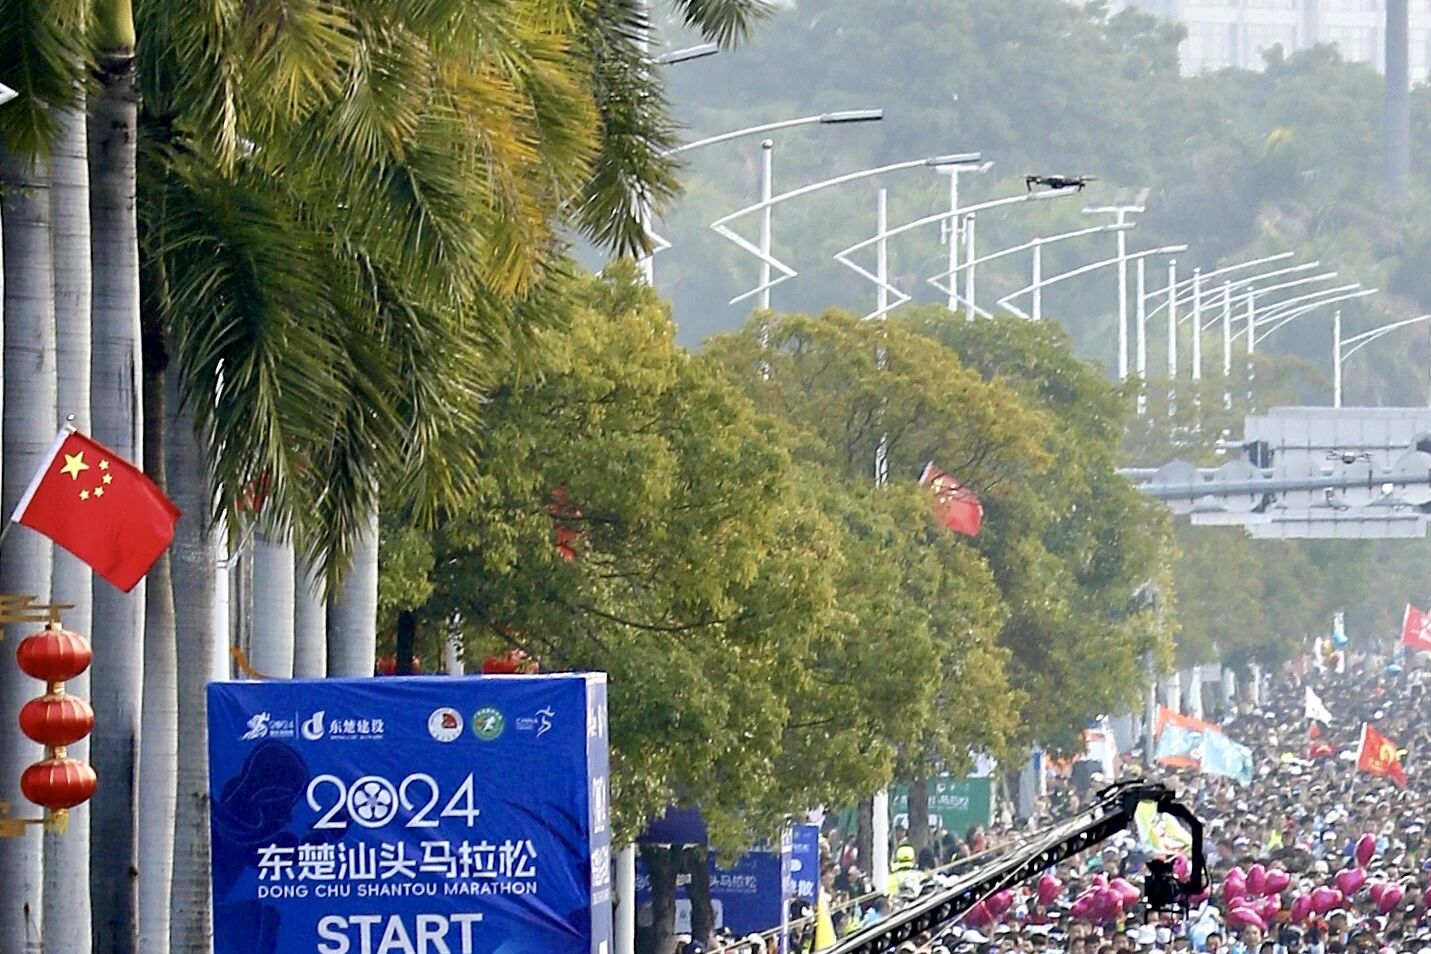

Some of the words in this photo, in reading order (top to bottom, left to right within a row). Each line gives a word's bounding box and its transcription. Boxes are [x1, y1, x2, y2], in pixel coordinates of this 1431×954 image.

[328, 718, 385, 734] 东楚建设
[306, 772, 480, 830] 2024
[256, 839, 537, 883] 东楚汕头马拉松
[258, 885, 308, 899] DONG
[314, 884, 351, 898] CHU
[357, 882, 438, 898] SHANTOU
[444, 880, 538, 896] MARATHON
